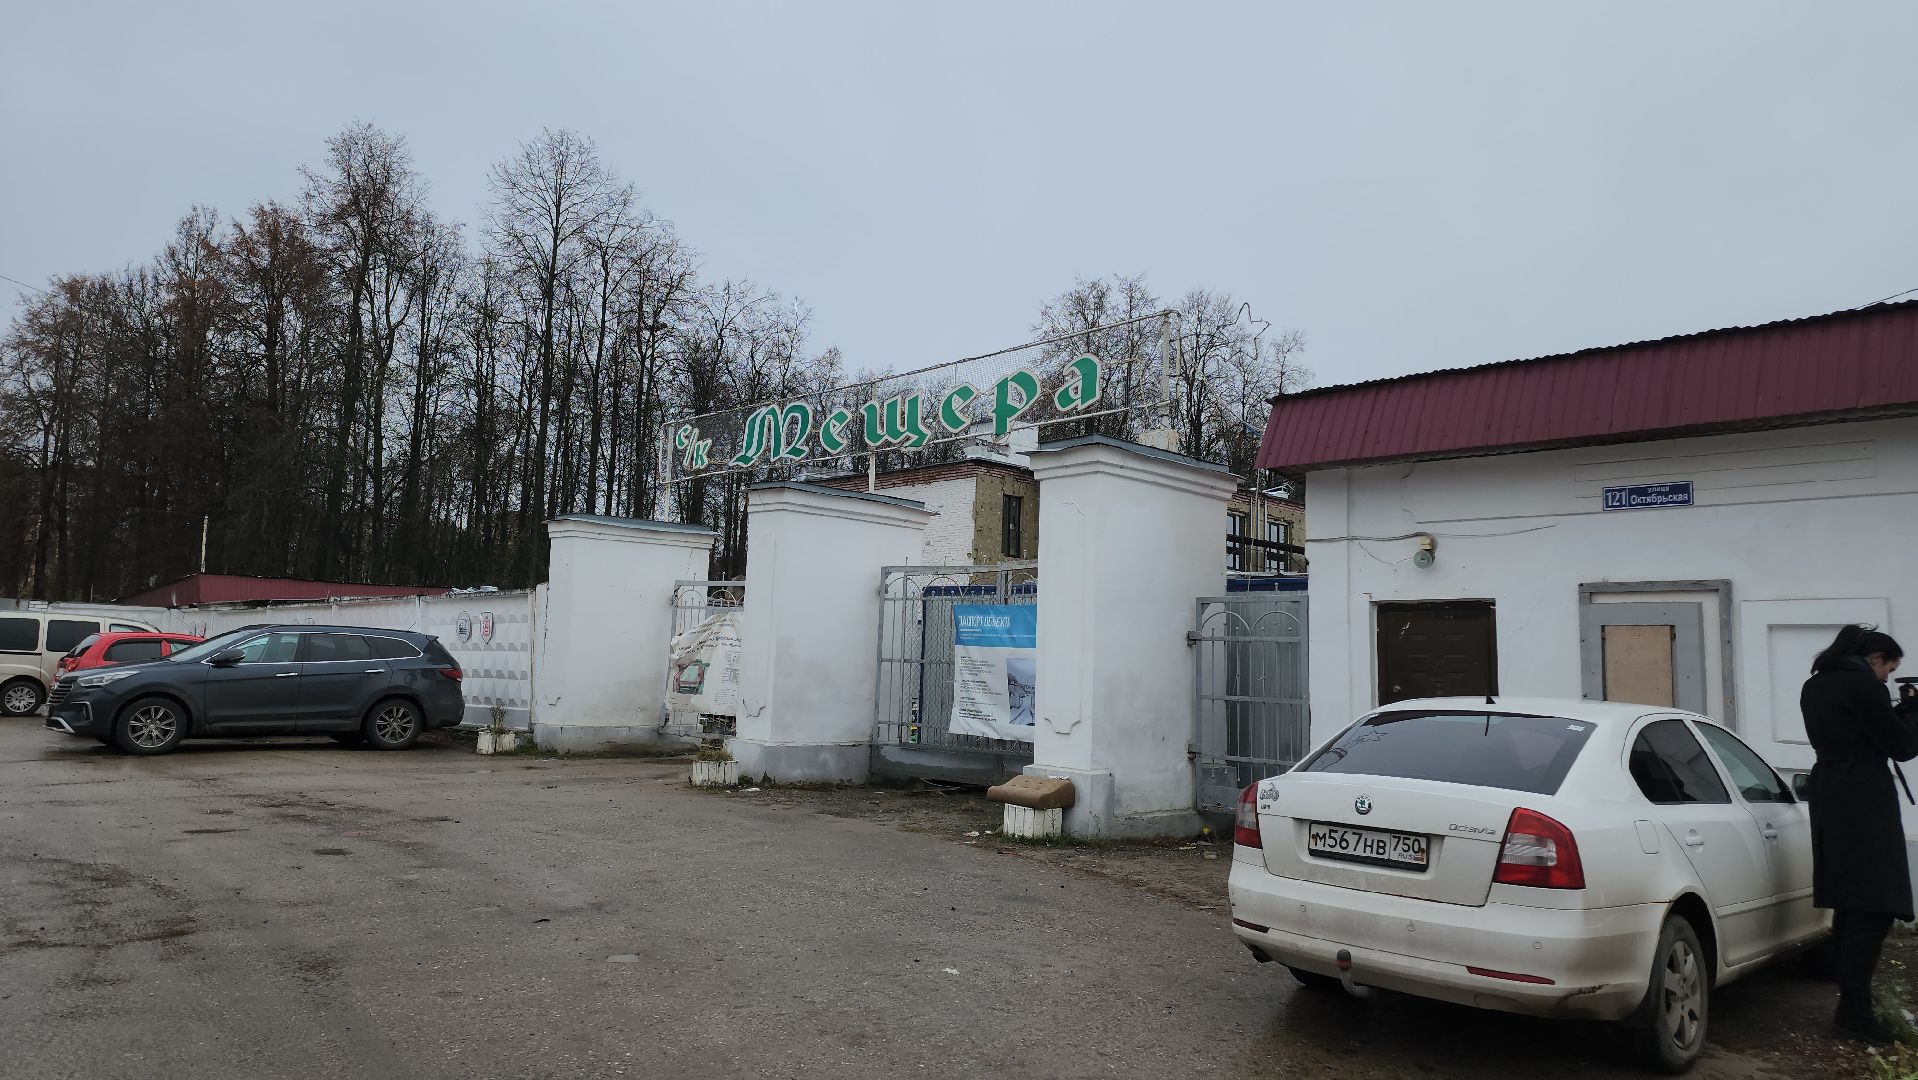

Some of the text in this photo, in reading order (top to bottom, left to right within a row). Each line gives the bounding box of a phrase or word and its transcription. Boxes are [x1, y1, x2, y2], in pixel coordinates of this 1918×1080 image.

[1647, 485, 1670, 493] улица
[1606, 491, 1626, 506] 121
[1631, 493, 1688, 505] Октябрьская
[959, 615, 1010, 628] ПАСПОРТ ОБЪЕКТА
[1448, 823, 1496, 835] Octavia
[1391, 835, 1422, 854] 750
[1398, 852, 1413, 861] RUS
